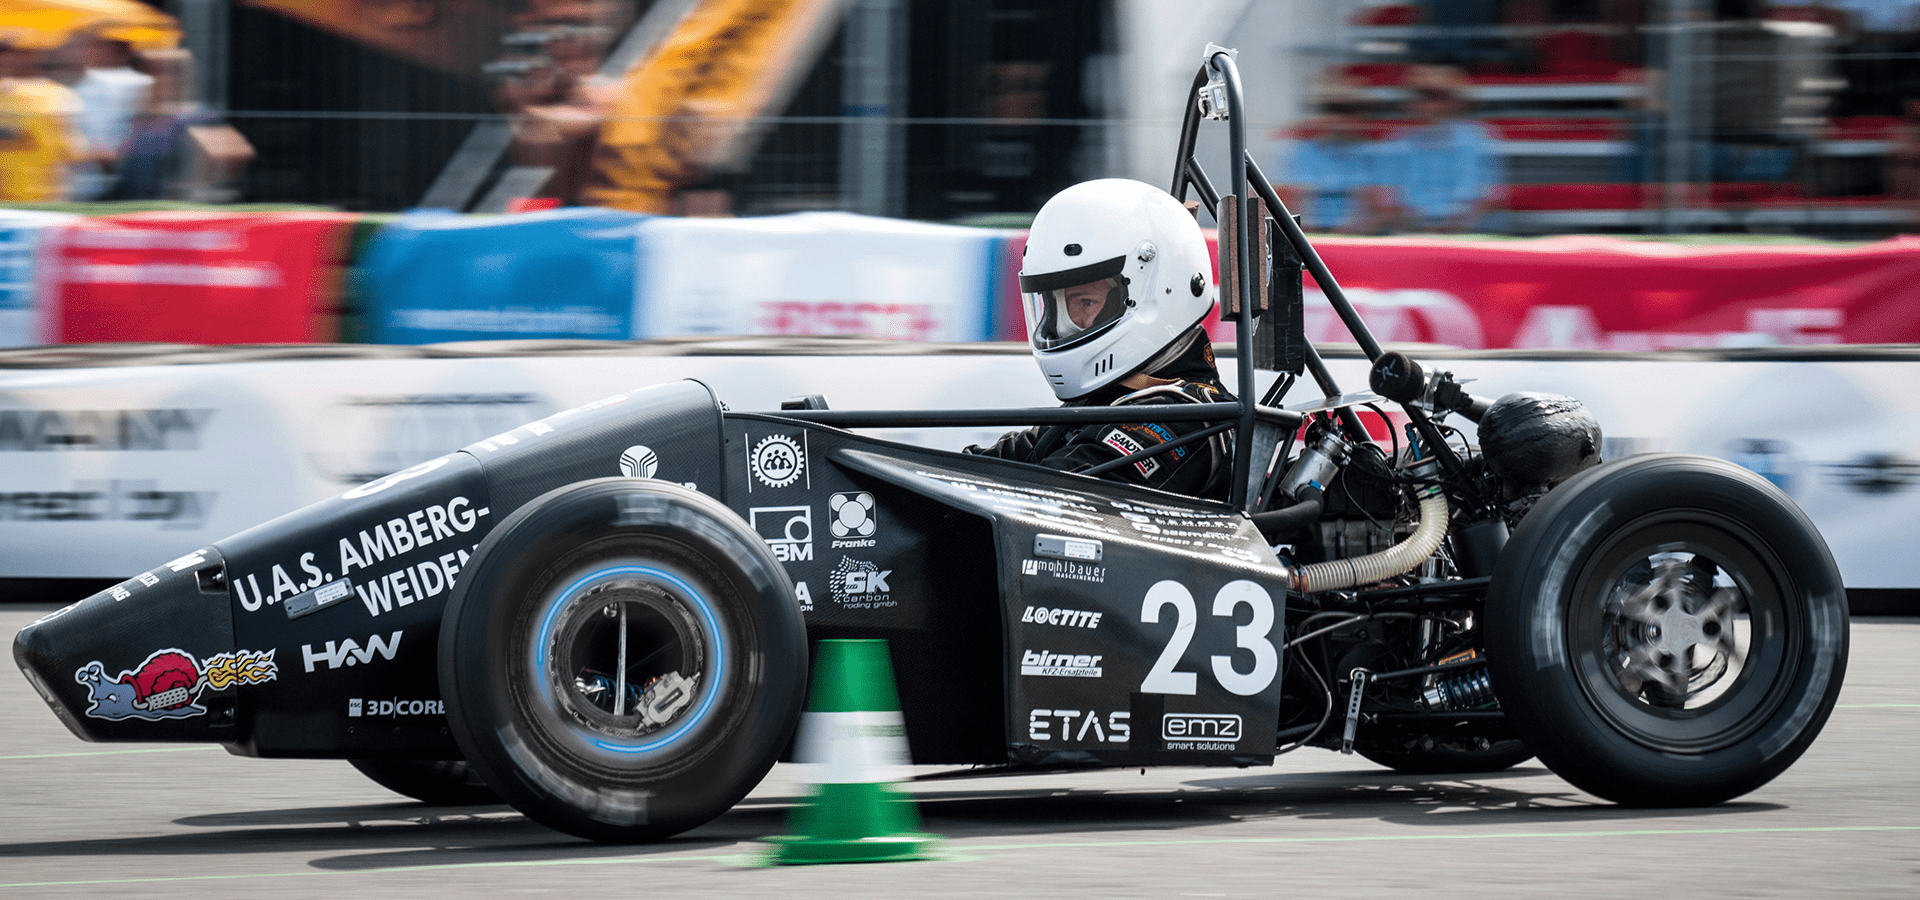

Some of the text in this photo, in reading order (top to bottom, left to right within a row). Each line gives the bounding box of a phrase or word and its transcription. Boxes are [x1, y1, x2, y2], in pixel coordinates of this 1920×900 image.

[1109, 432, 1156, 471] SANDTER
[831, 538, 876, 549] Franke
[233, 496, 490, 612] U.A.S. AMBERG-
[1055, 572, 1105, 583] MASCHINENBAU
[843, 593, 890, 602] carbon
[843, 601, 898, 610] roding gmbh
[1021, 606, 1103, 629] LOCTITE
[1140, 579, 1278, 696] 23
[1021, 649, 1103, 668] birner
[1029, 709, 1131, 742] ETAS
[1168, 718, 1236, 736] emz
[1167, 741, 1235, 750] smart solutions
